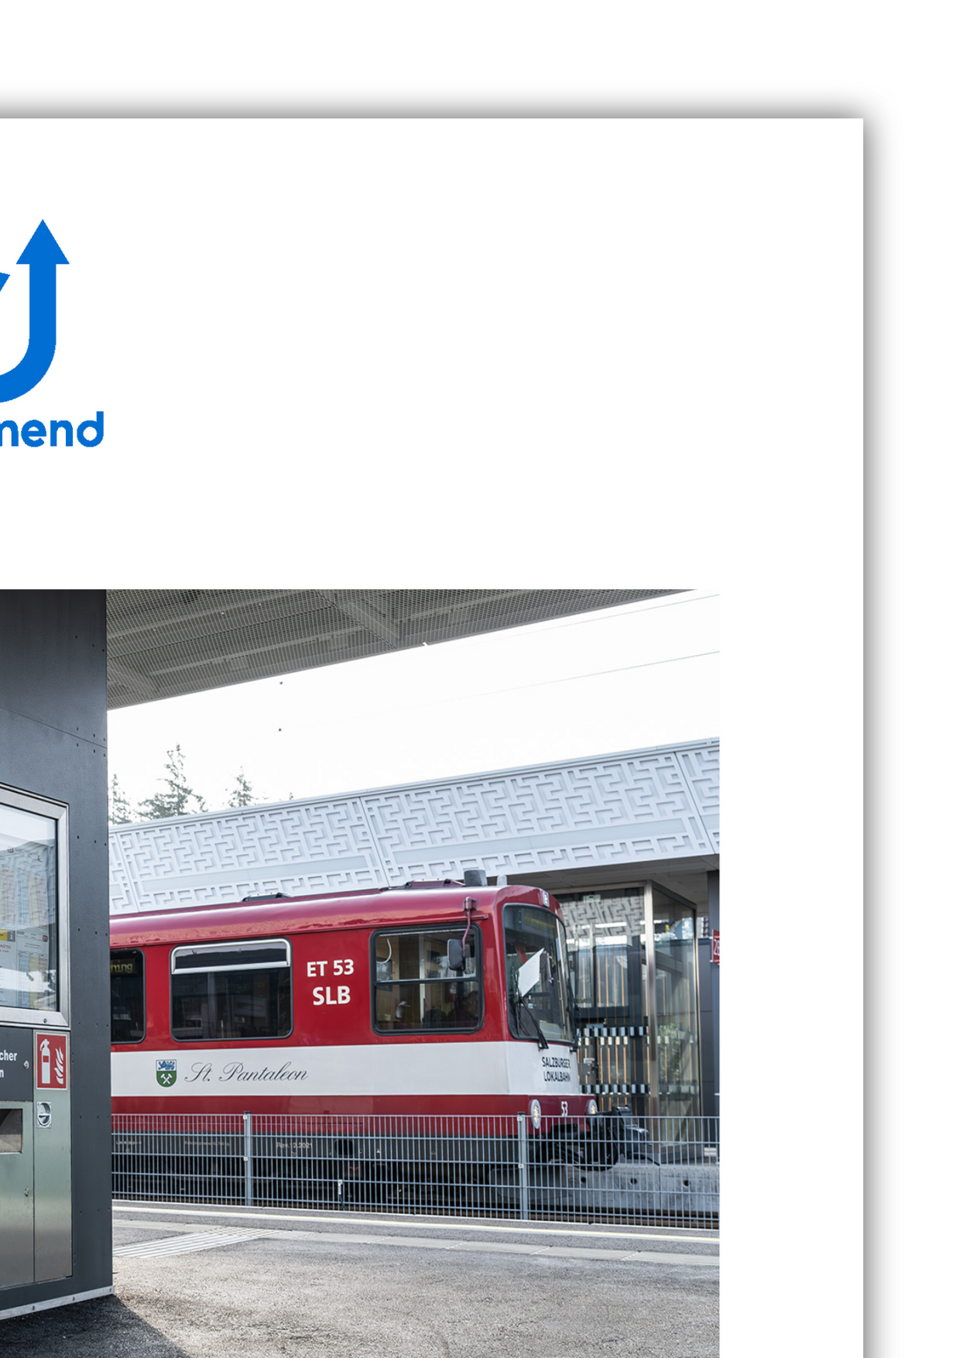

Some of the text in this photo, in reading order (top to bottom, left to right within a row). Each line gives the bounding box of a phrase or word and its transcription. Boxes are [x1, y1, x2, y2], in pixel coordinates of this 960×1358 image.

[306, 959, 355, 977] ET 53
[312, 985, 351, 1006] SLB
[184, 1061, 309, 1082] St. Pantaleon
